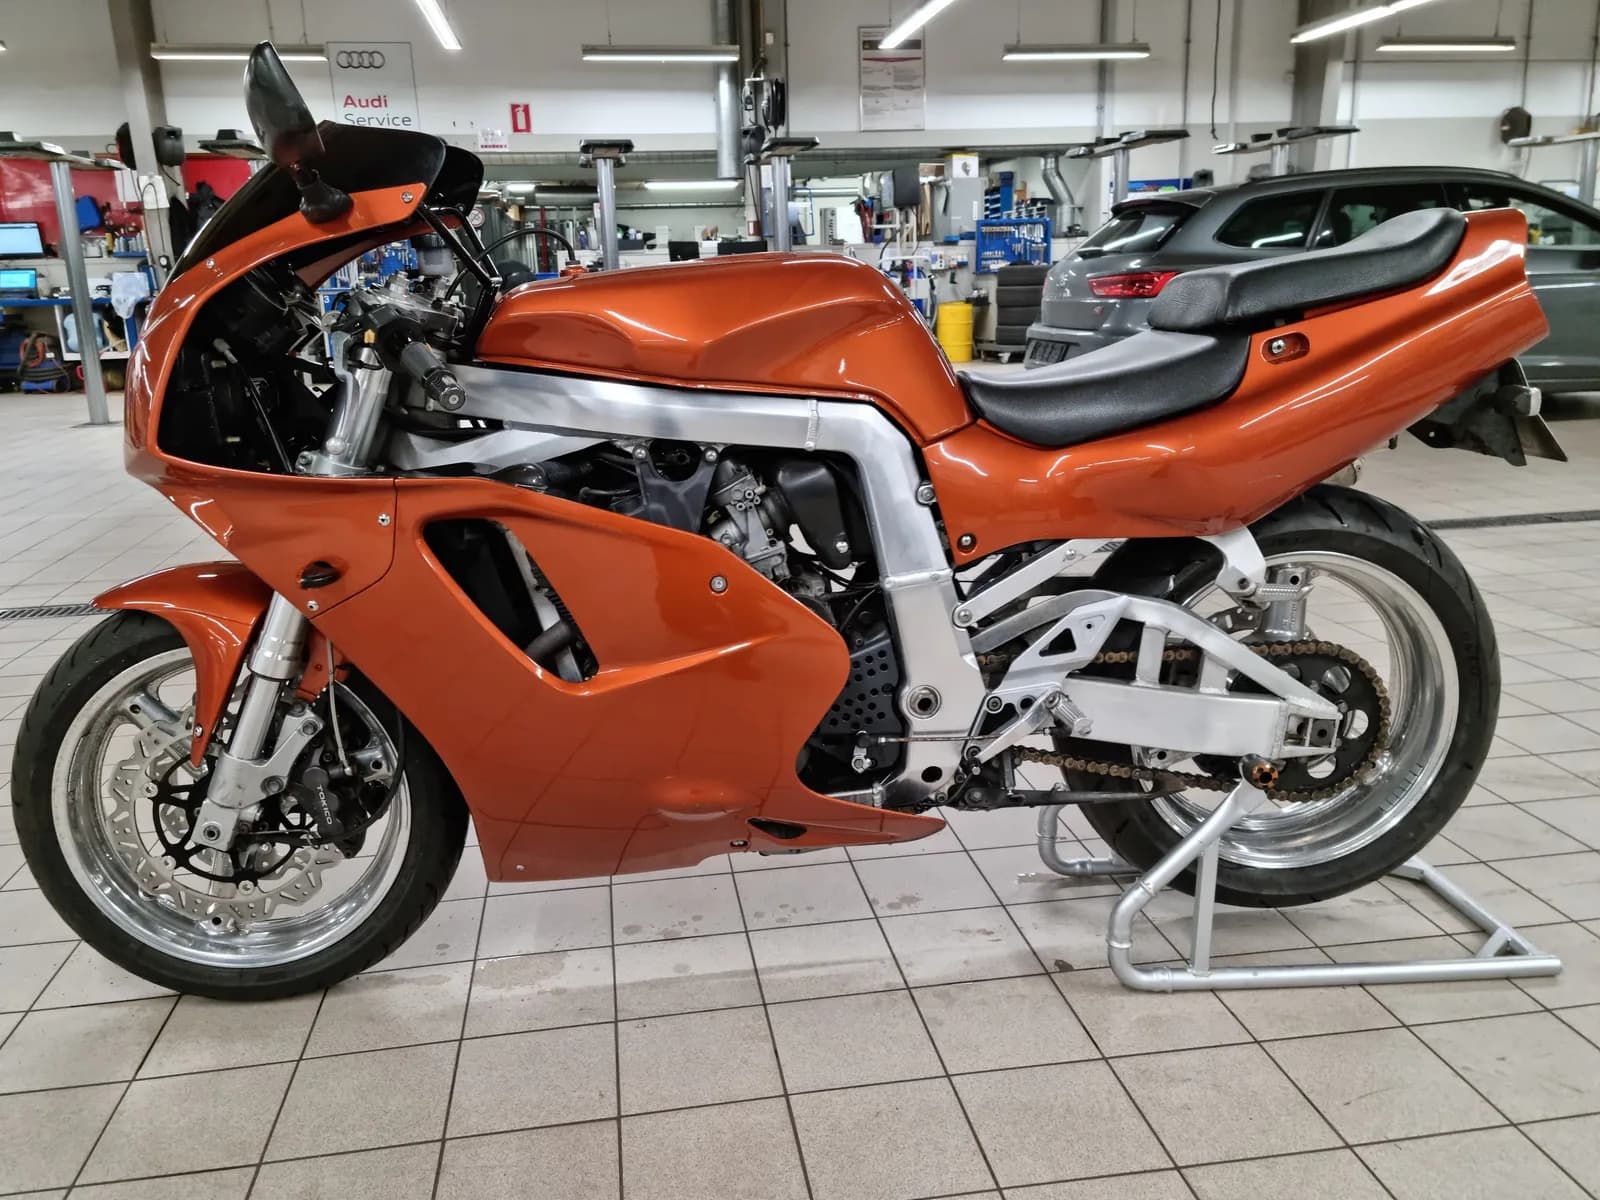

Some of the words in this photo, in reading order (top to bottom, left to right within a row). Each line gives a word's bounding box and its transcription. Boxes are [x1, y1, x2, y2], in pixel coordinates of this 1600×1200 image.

[343, 95, 388, 108] Audi
[344, 113, 412, 126] Service
[316, 784, 333, 825] TOKICO
